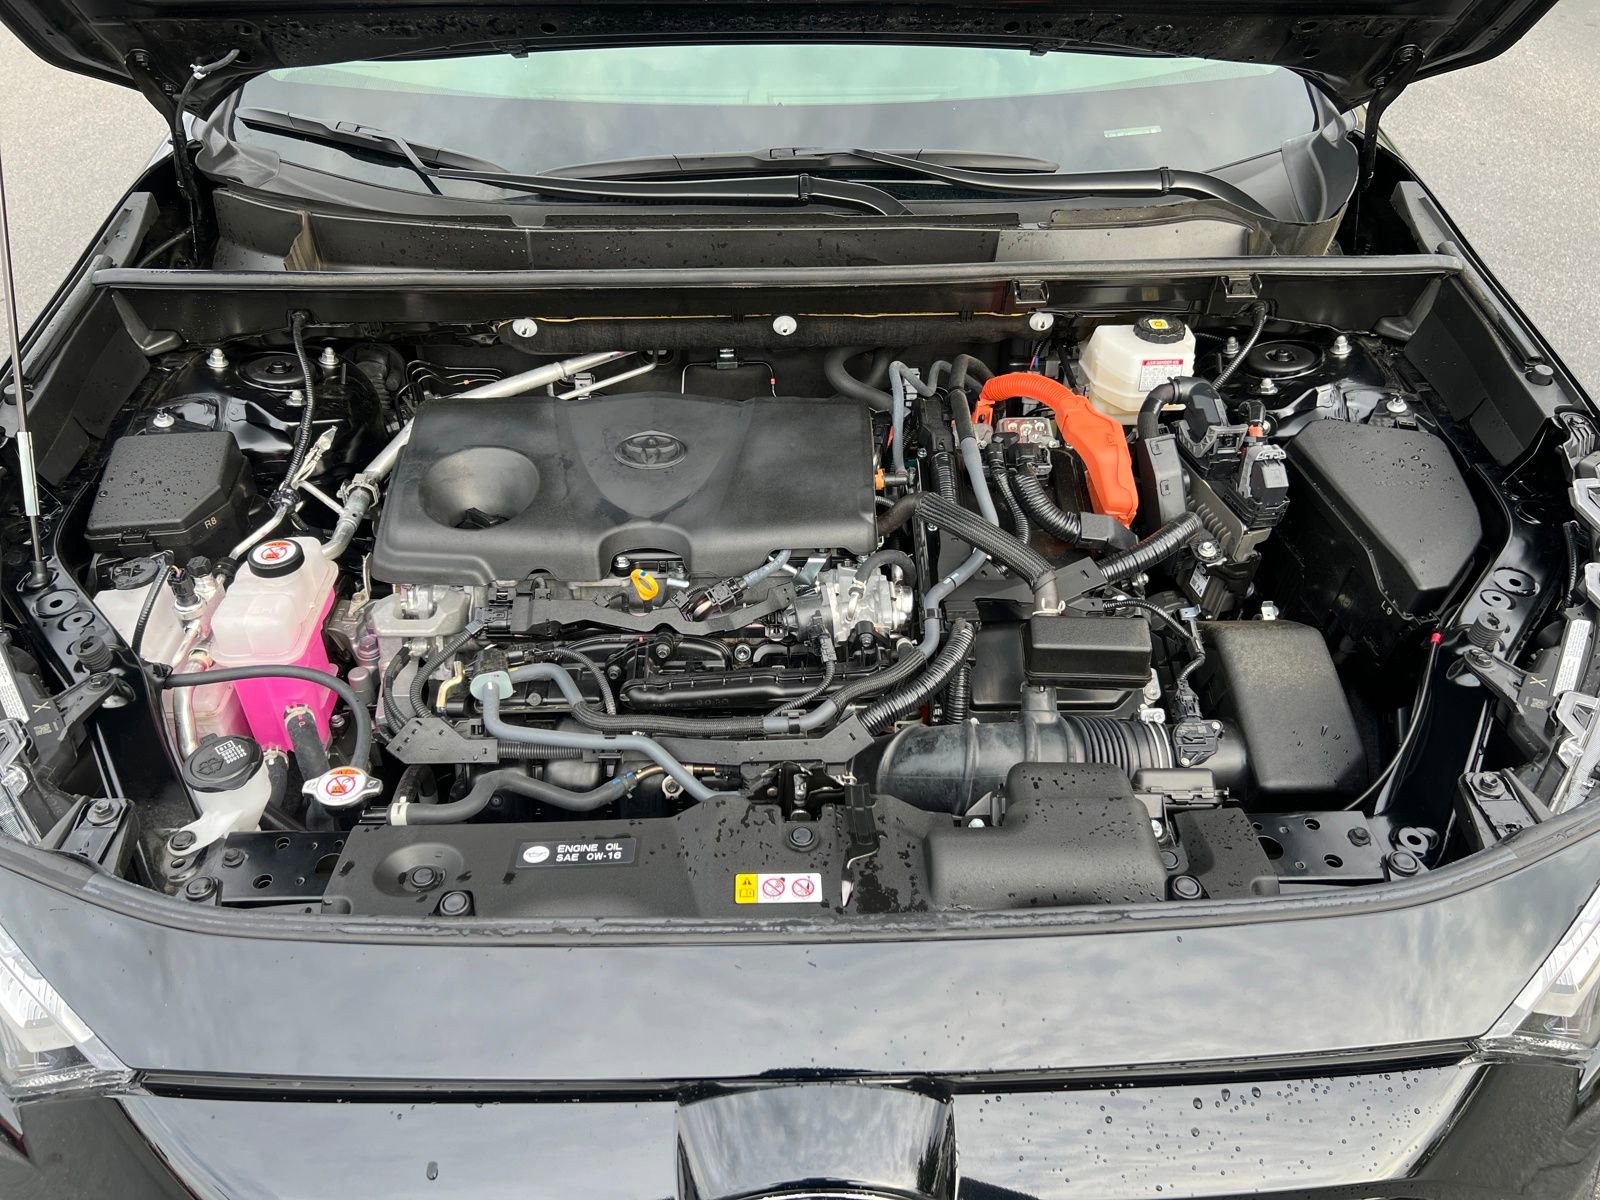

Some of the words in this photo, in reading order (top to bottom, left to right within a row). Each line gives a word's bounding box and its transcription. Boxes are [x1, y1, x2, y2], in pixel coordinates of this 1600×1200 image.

[557, 844, 599, 853] ENGINE
[605, 842, 623, 852] OIL
[556, 853, 580, 862] SAE
[586, 851, 622, 861] 0W-16
